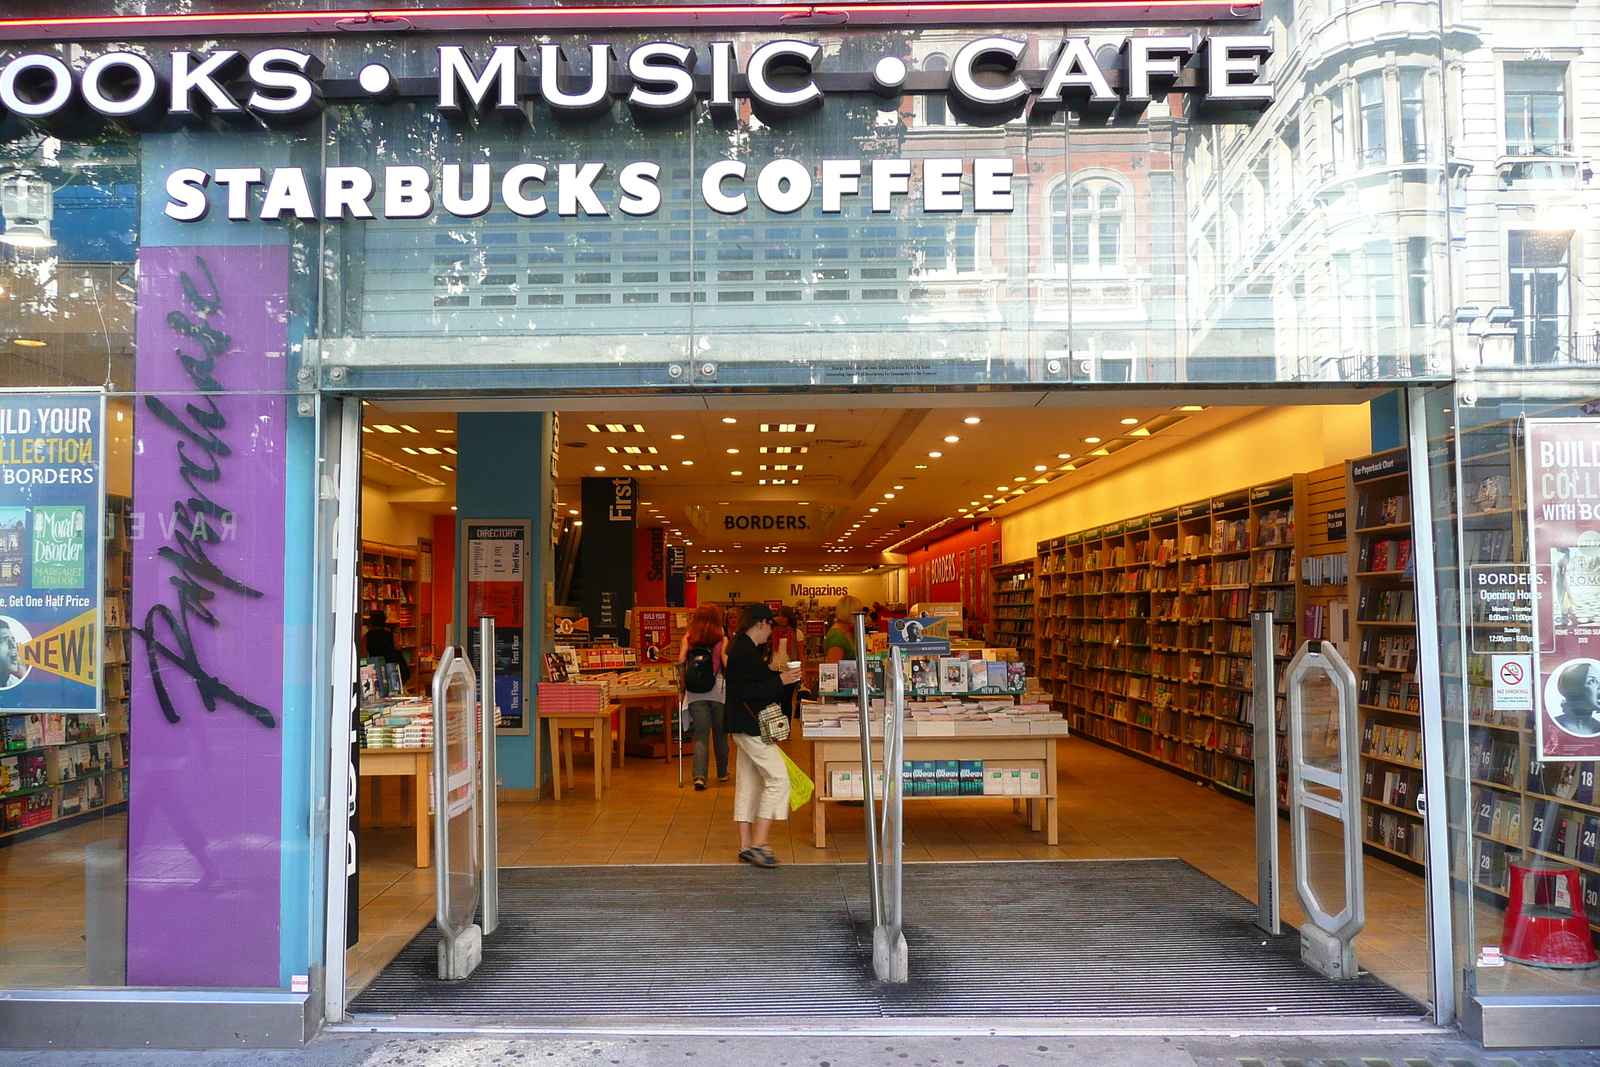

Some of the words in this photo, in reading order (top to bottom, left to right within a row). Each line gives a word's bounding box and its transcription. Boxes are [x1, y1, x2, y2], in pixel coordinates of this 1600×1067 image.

[0, 48, 315, 117] OOKS
[437, 39, 823, 113] MUSIC
[951, 33, 1275, 105] CAFE
[164, 161, 662, 221] STARBUCKS
[701, 158, 1014, 214] COFFEE
[38, 408, 92, 434] YOUR
[1540, 441, 1600, 468] BUILD
[1362, 462, 1382, 475] Paperback
[1382, 460, 1394, 468] Chart
[4, 468, 94, 484] BORDERS
[1542, 472, 1600, 499] COLL
[609, 478, 632, 521] First
[1361, 506, 1363, 516] 1
[1542, 504, 1576, 520] WITH
[43, 511, 76, 542] Moral
[477, 529, 517, 538] DIRECTORY
[34, 538, 82, 563] Disorder
[647, 527, 664, 581] Second
[1361, 549, 1365, 560] 2
[671, 546, 684, 576] Third
[35, 567, 82, 576] MARGARET
[39, 576, 77, 585] ATWOOD
[790, 584, 848, 598] Magazines
[1480, 590, 1515, 601] Opening
[1517, 590, 1542, 599] Hous
[10, 594, 24, 607] Get
[26, 595, 43, 607] One
[46, 595, 64, 607] Half
[66, 594, 89, 607] Price
[1361, 598, 1365, 608] 5
[24, 623, 94, 680] NEW!
[1363, 640, 1367, 651] 8
[1361, 680, 1368, 691] 11
[1365, 729, 1371, 740] 14
[1482, 751, 1490, 765] 16
[1530, 761, 1540, 776] 17
[1365, 773, 1372, 784] 19
[1581, 771, 1593, 786] 18
[1399, 782, 1406, 794] 20
[1481, 804, 1491, 818] 22
[1397, 827, 1404, 838] 26
[1533, 817, 1544, 833] 23
[1583, 831, 1595, 847] 24
[1481, 855, 1490, 869] 28
[1586, 890, 1598, 905] 30
